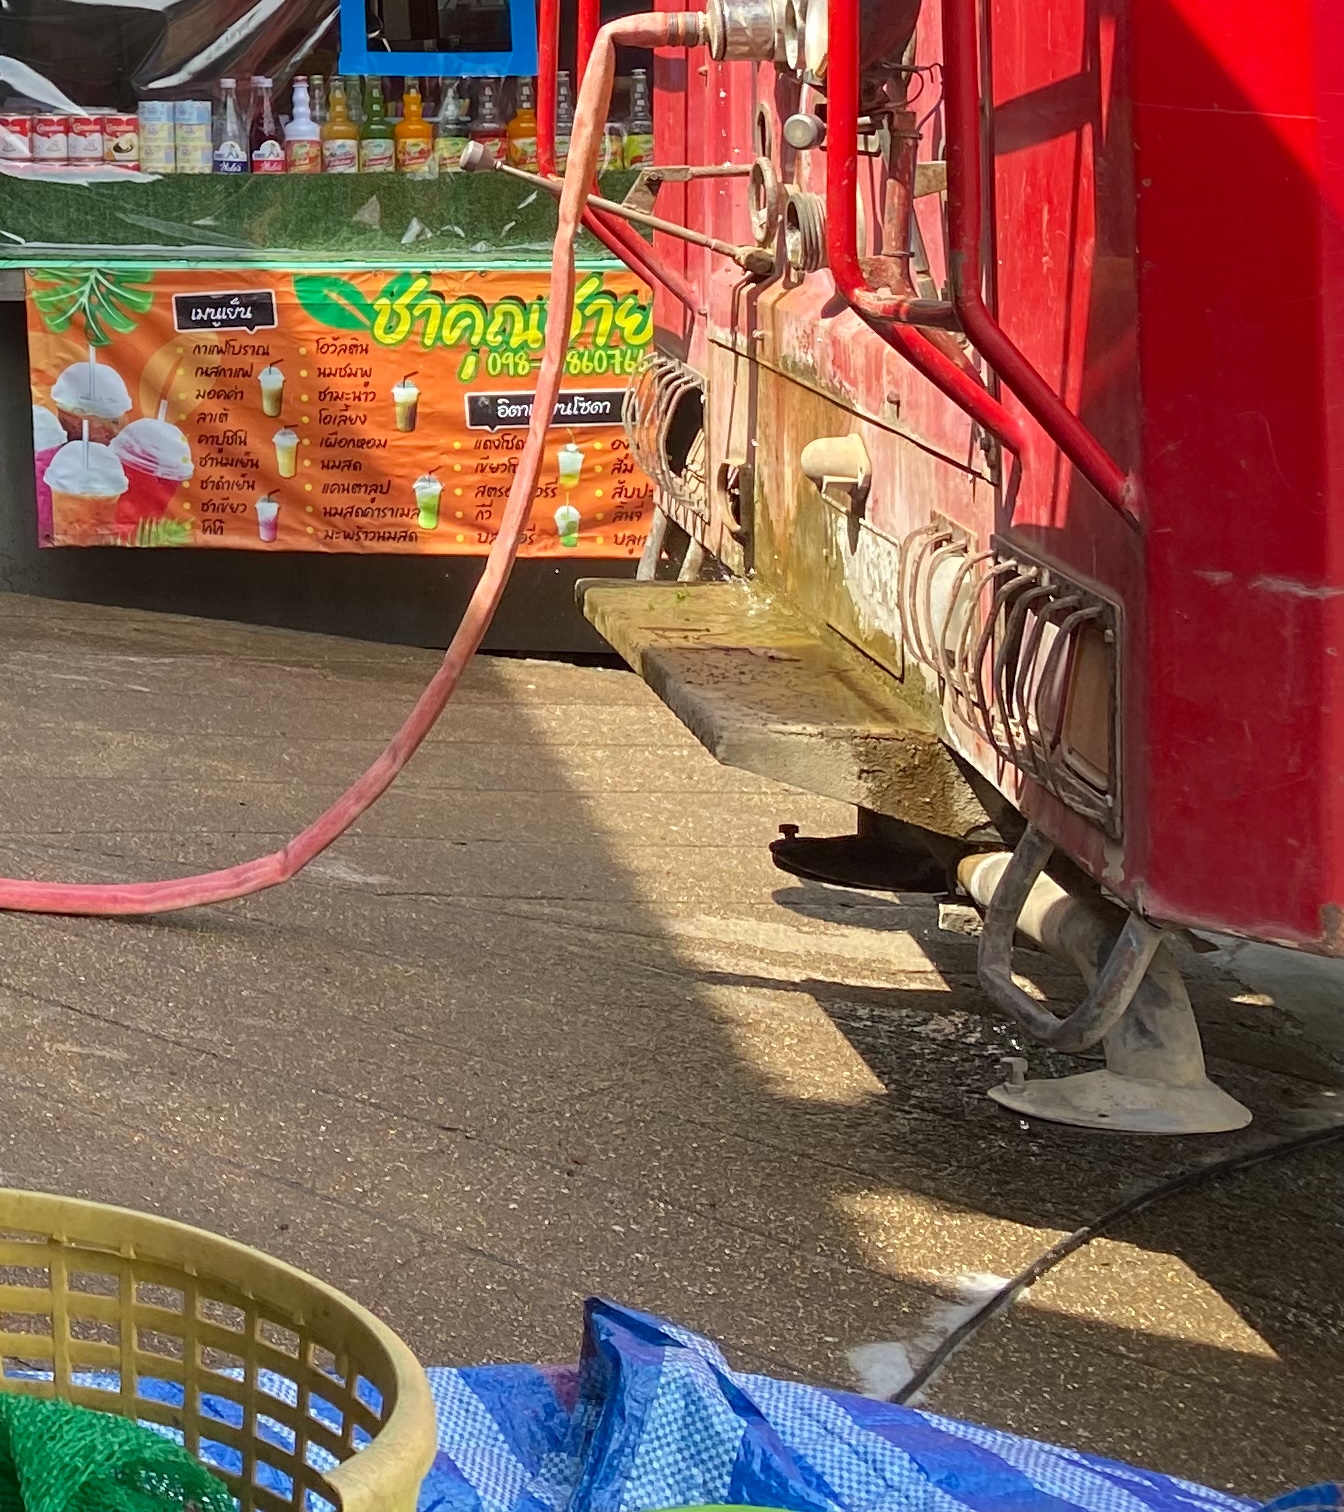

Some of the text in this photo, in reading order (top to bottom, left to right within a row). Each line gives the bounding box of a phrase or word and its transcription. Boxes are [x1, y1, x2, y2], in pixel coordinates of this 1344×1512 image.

[191, 297, 253, 327] เมนูเย็น
[192, 339, 271, 356] กาแฟโบราณ
[315, 336, 369, 356] โอวัลติน
[316, 363, 373, 387] นมชมพู
[317, 386, 377, 402] ชามะนาว
[318, 404, 368, 426] โอเลี้ยง
[319, 431, 389, 449] เผือกหอม
[199, 451, 260, 469] ชานมเย็น
[320, 459, 363, 472] นมสด
[321, 479, 392, 504] แคนตาลูป
[201, 496, 247, 514] ชาเขียว
[322, 505, 422, 520] นมสดคาราเมล
[323, 525, 418, 543] มะพร้าวนมสด
